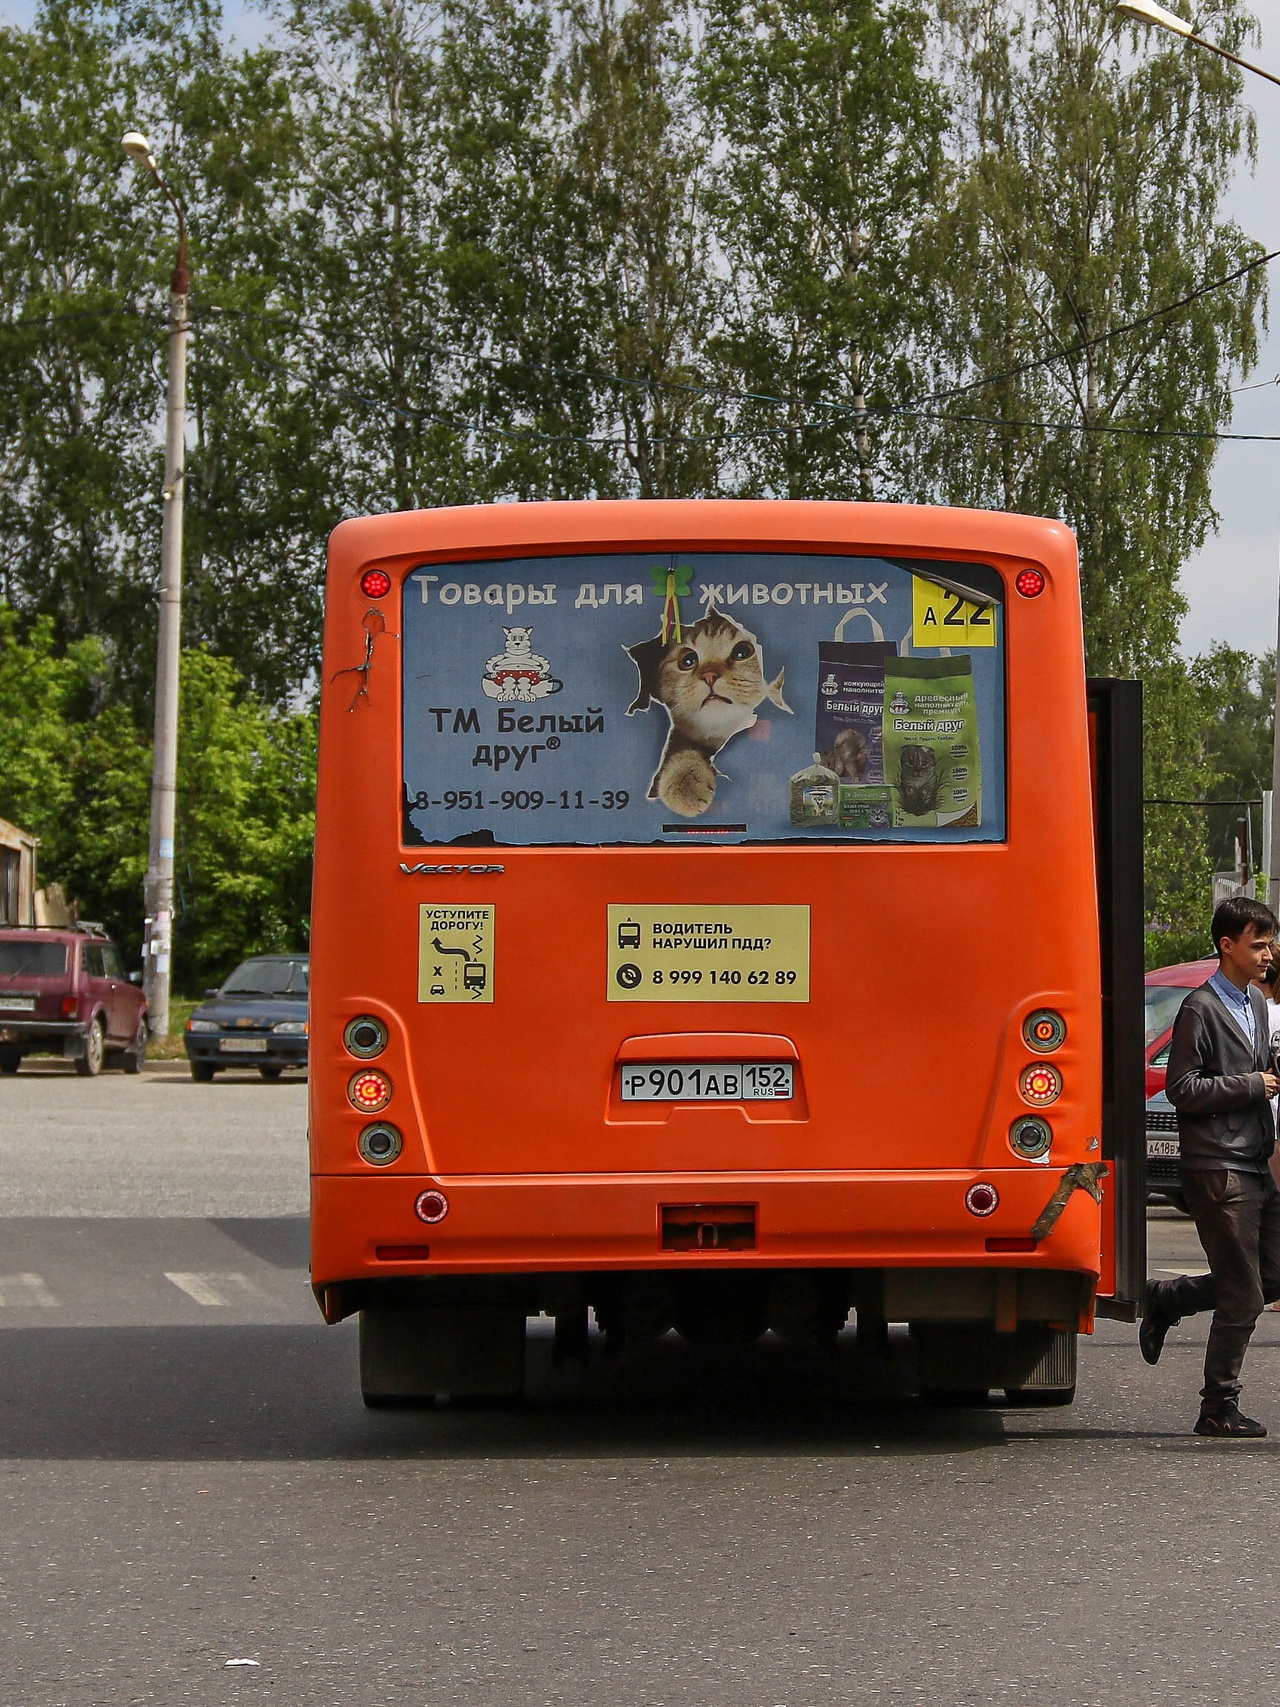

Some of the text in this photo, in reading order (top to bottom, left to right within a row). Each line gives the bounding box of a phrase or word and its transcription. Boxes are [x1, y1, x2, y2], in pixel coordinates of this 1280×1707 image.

[411, 575, 889, 615] Товары для животных
[914, 692, 969, 702] древесный
[826, 700, 884, 716] Белый друг
[428, 707, 605, 733] ТМ Белый
[894, 719, 965, 732] Белый друг
[415, 789, 630, 811] 8-951-909-11-39
[426, 910, 490, 920] УСТУПИТЕ
[430, 921, 484, 931] ДОРОГУ!
[652, 923, 733, 936] ВОДИТЕЛЬ
[652, 938, 772, 951] НАРУШИЛ ПДД?
[652, 970, 797, 985] 8 999 140 62 89
[745, 1067, 786, 1088] 152
[753, 1088, 774, 1096] RUS
